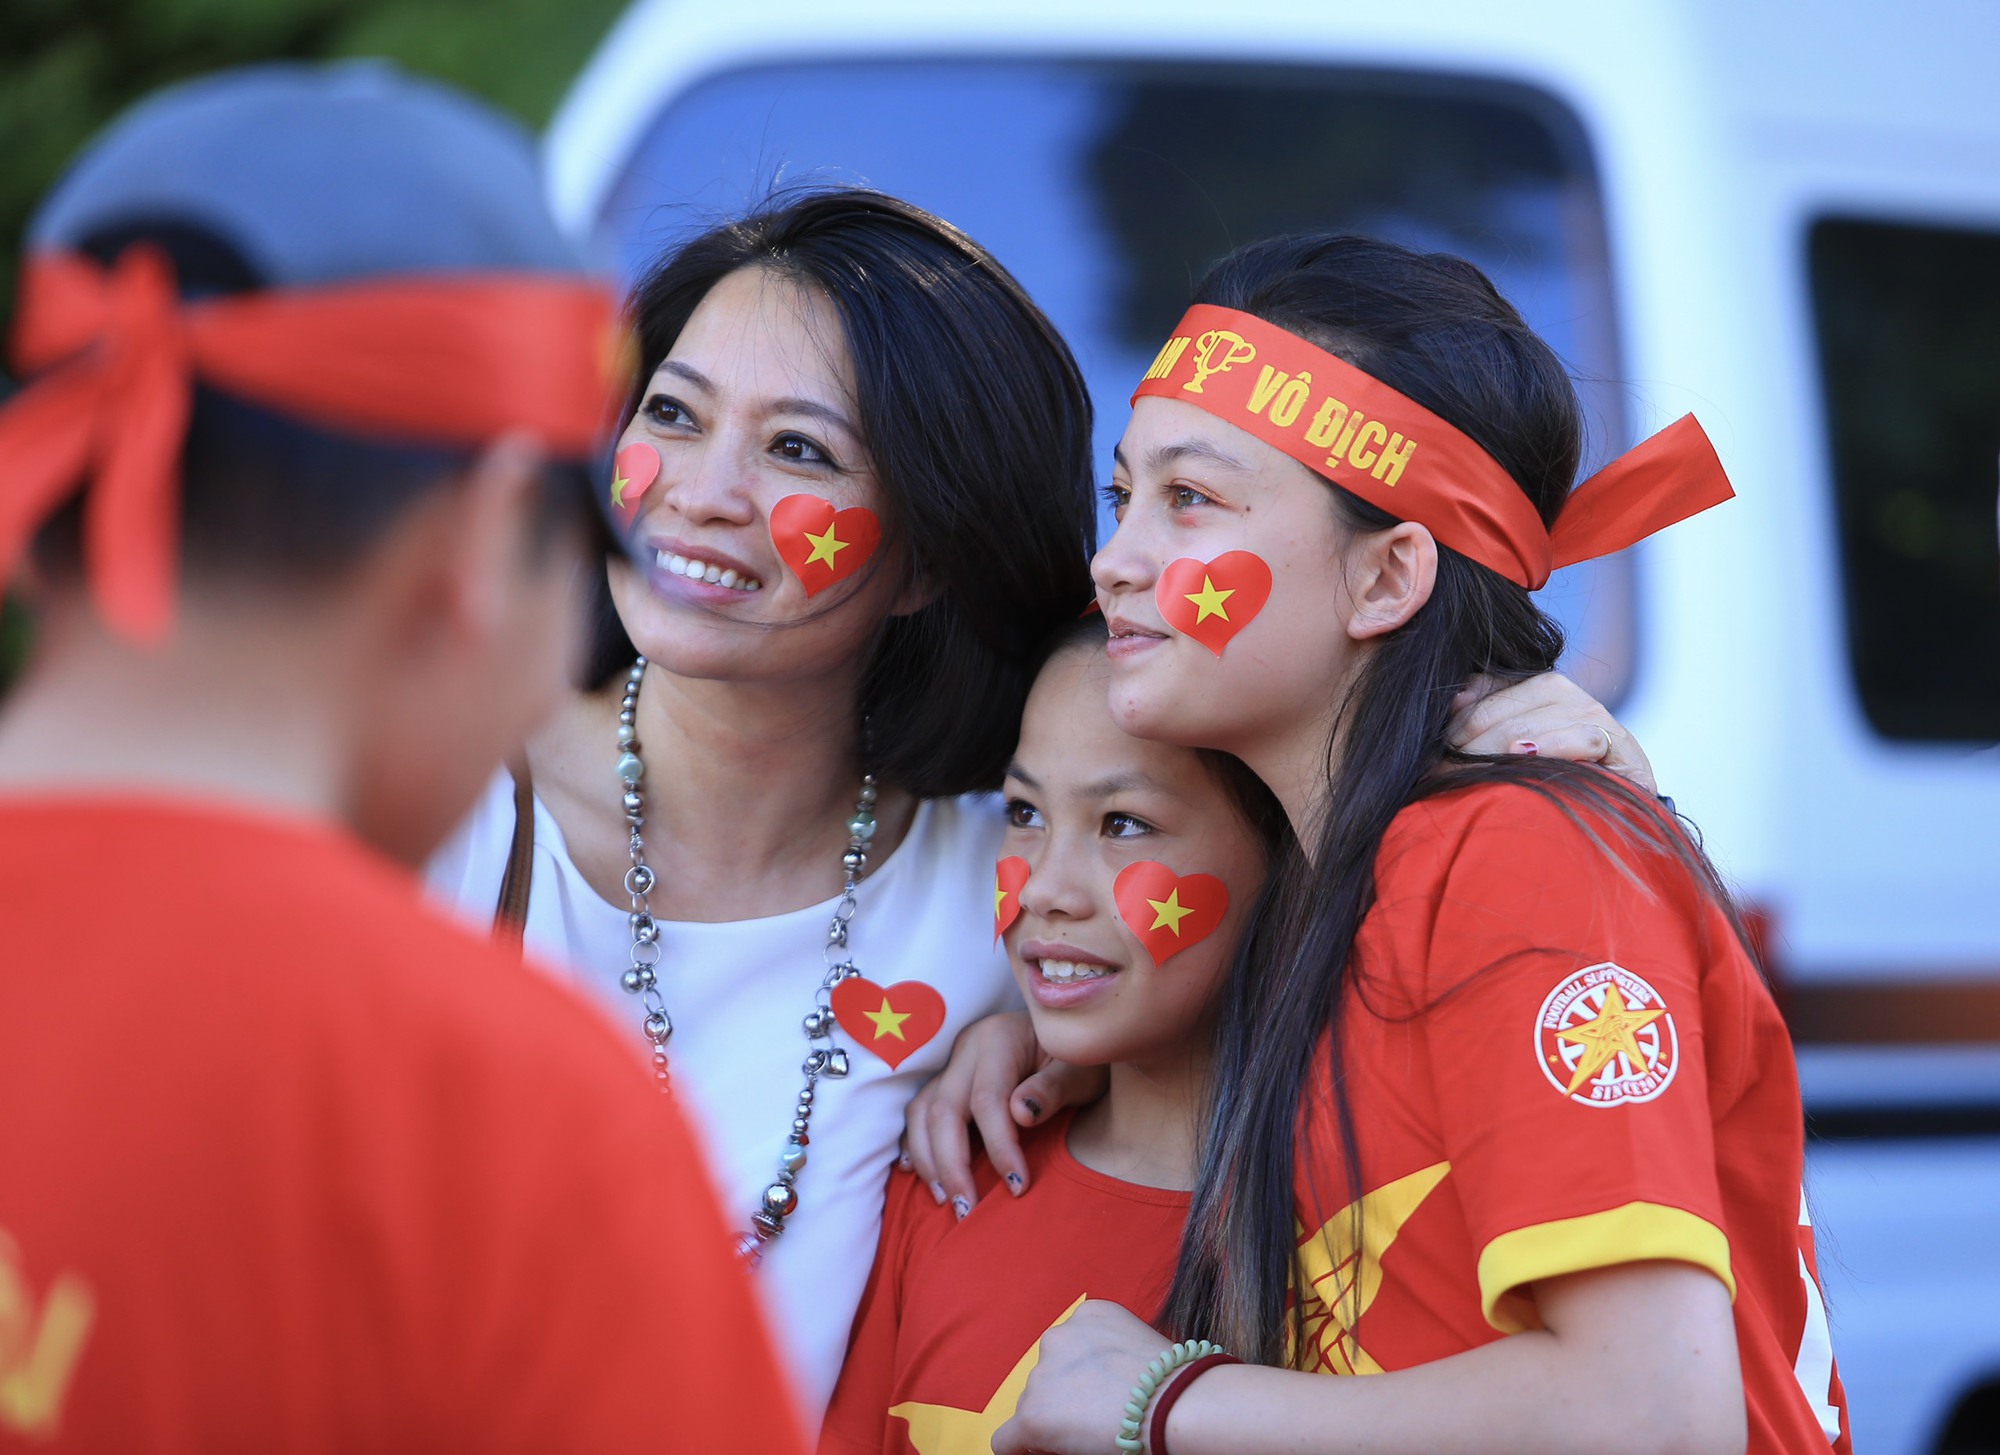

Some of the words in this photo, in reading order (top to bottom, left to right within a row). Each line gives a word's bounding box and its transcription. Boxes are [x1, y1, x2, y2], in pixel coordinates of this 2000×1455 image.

[1246, 364, 1313, 428] VÔ
[1303, 395, 1418, 488] ĐỊCH
[1543, 980, 1587, 1030] FOOTBALL
[1583, 968, 1653, 1004] SUPPORTERS
